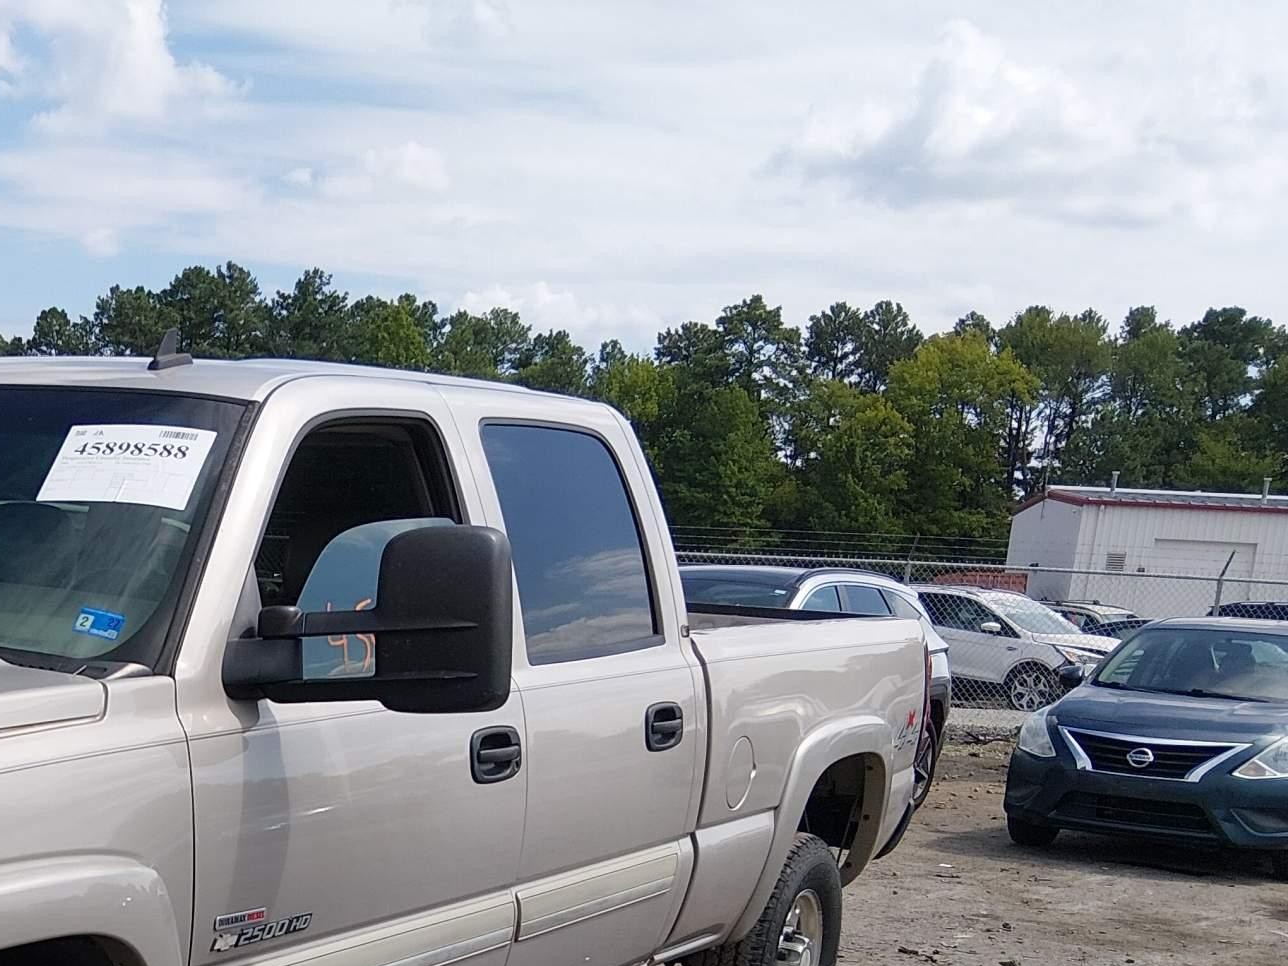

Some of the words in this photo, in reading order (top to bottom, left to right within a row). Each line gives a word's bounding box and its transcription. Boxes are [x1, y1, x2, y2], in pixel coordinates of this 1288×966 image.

[74, 441, 190, 460] 45898588
[79, 616, 89, 627] 2
[239, 919, 290, 946] 2500
[290, 914, 312, 931] HD
